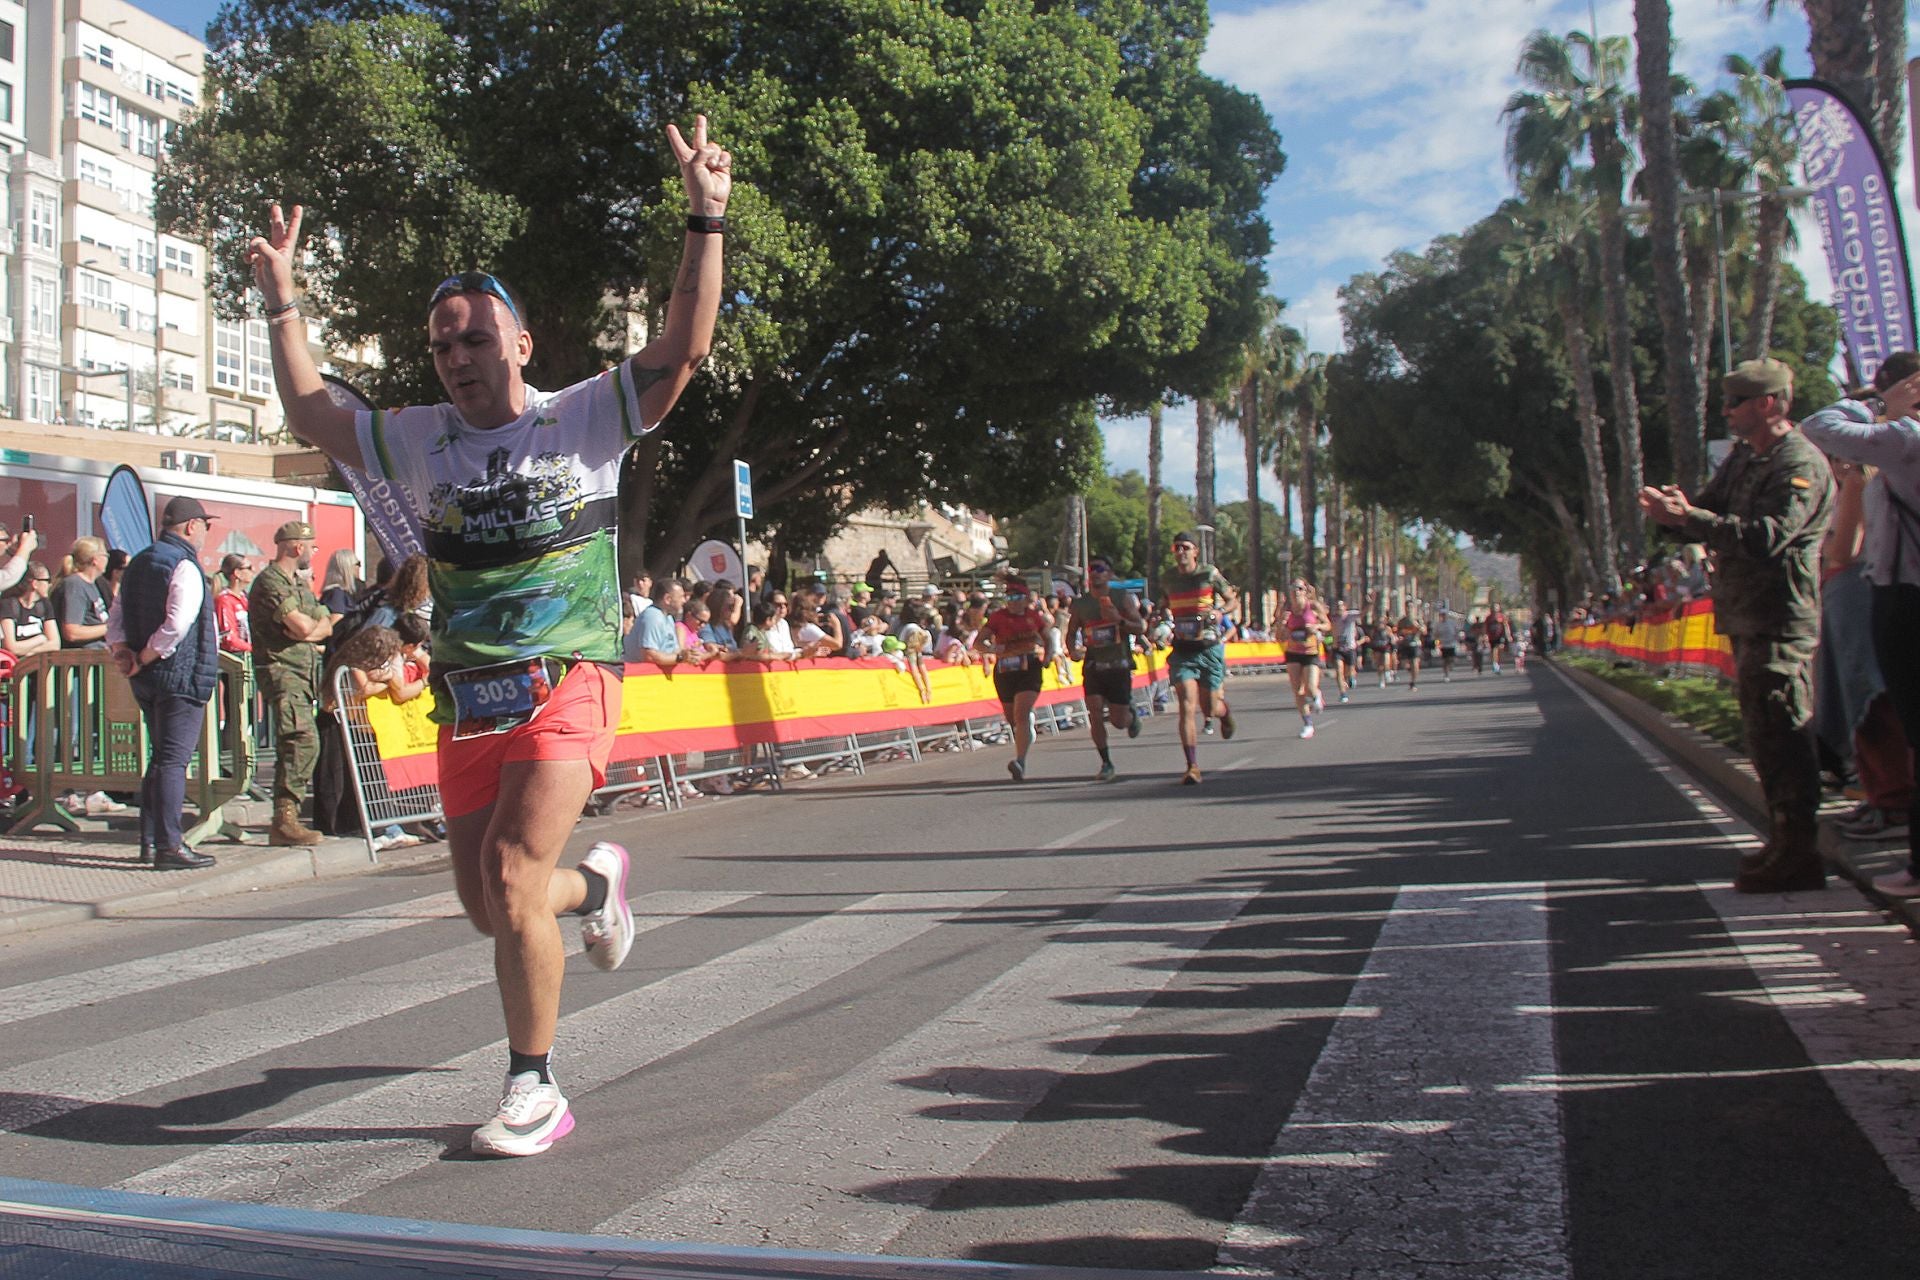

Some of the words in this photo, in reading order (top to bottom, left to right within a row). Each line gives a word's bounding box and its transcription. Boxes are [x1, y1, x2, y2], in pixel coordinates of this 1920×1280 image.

[465, 499, 558, 532] MILLAS
[464, 533, 481, 543] DE
[481, 526, 511, 544] LA
[514, 516, 564, 541] RAYA
[473, 678, 519, 705] 303
